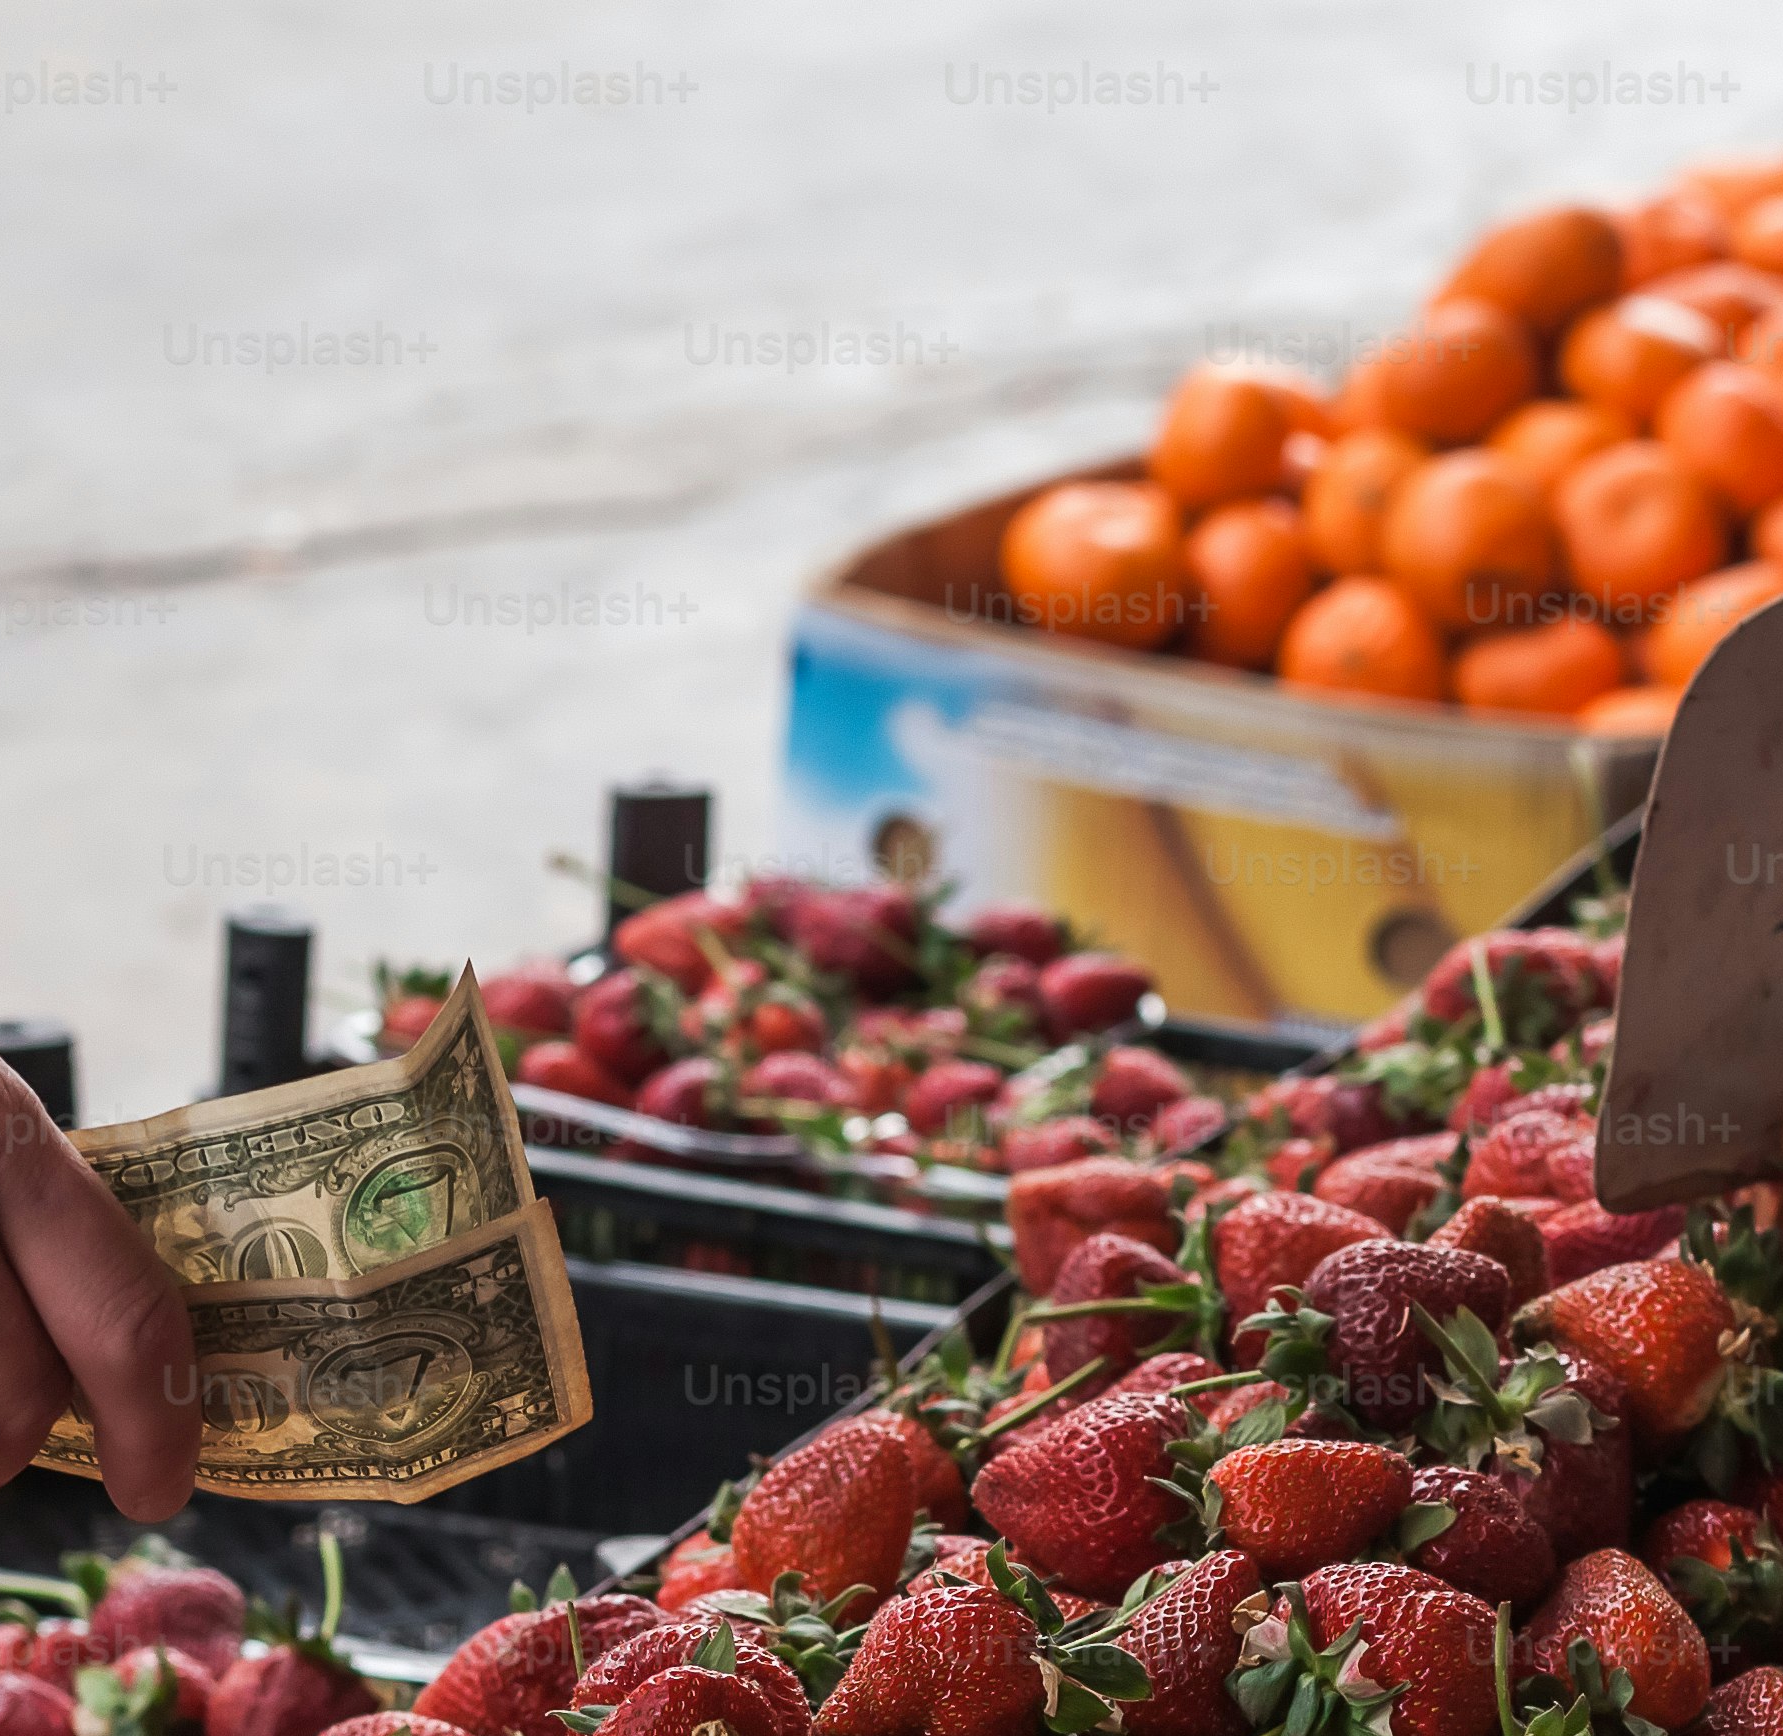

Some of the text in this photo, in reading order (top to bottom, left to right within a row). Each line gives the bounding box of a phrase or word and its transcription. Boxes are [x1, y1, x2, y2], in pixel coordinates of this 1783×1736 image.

[246, 1101, 406, 1158] ONE
[219, 1300, 378, 1322] ONE
[387, 1448, 458, 1480] THE
